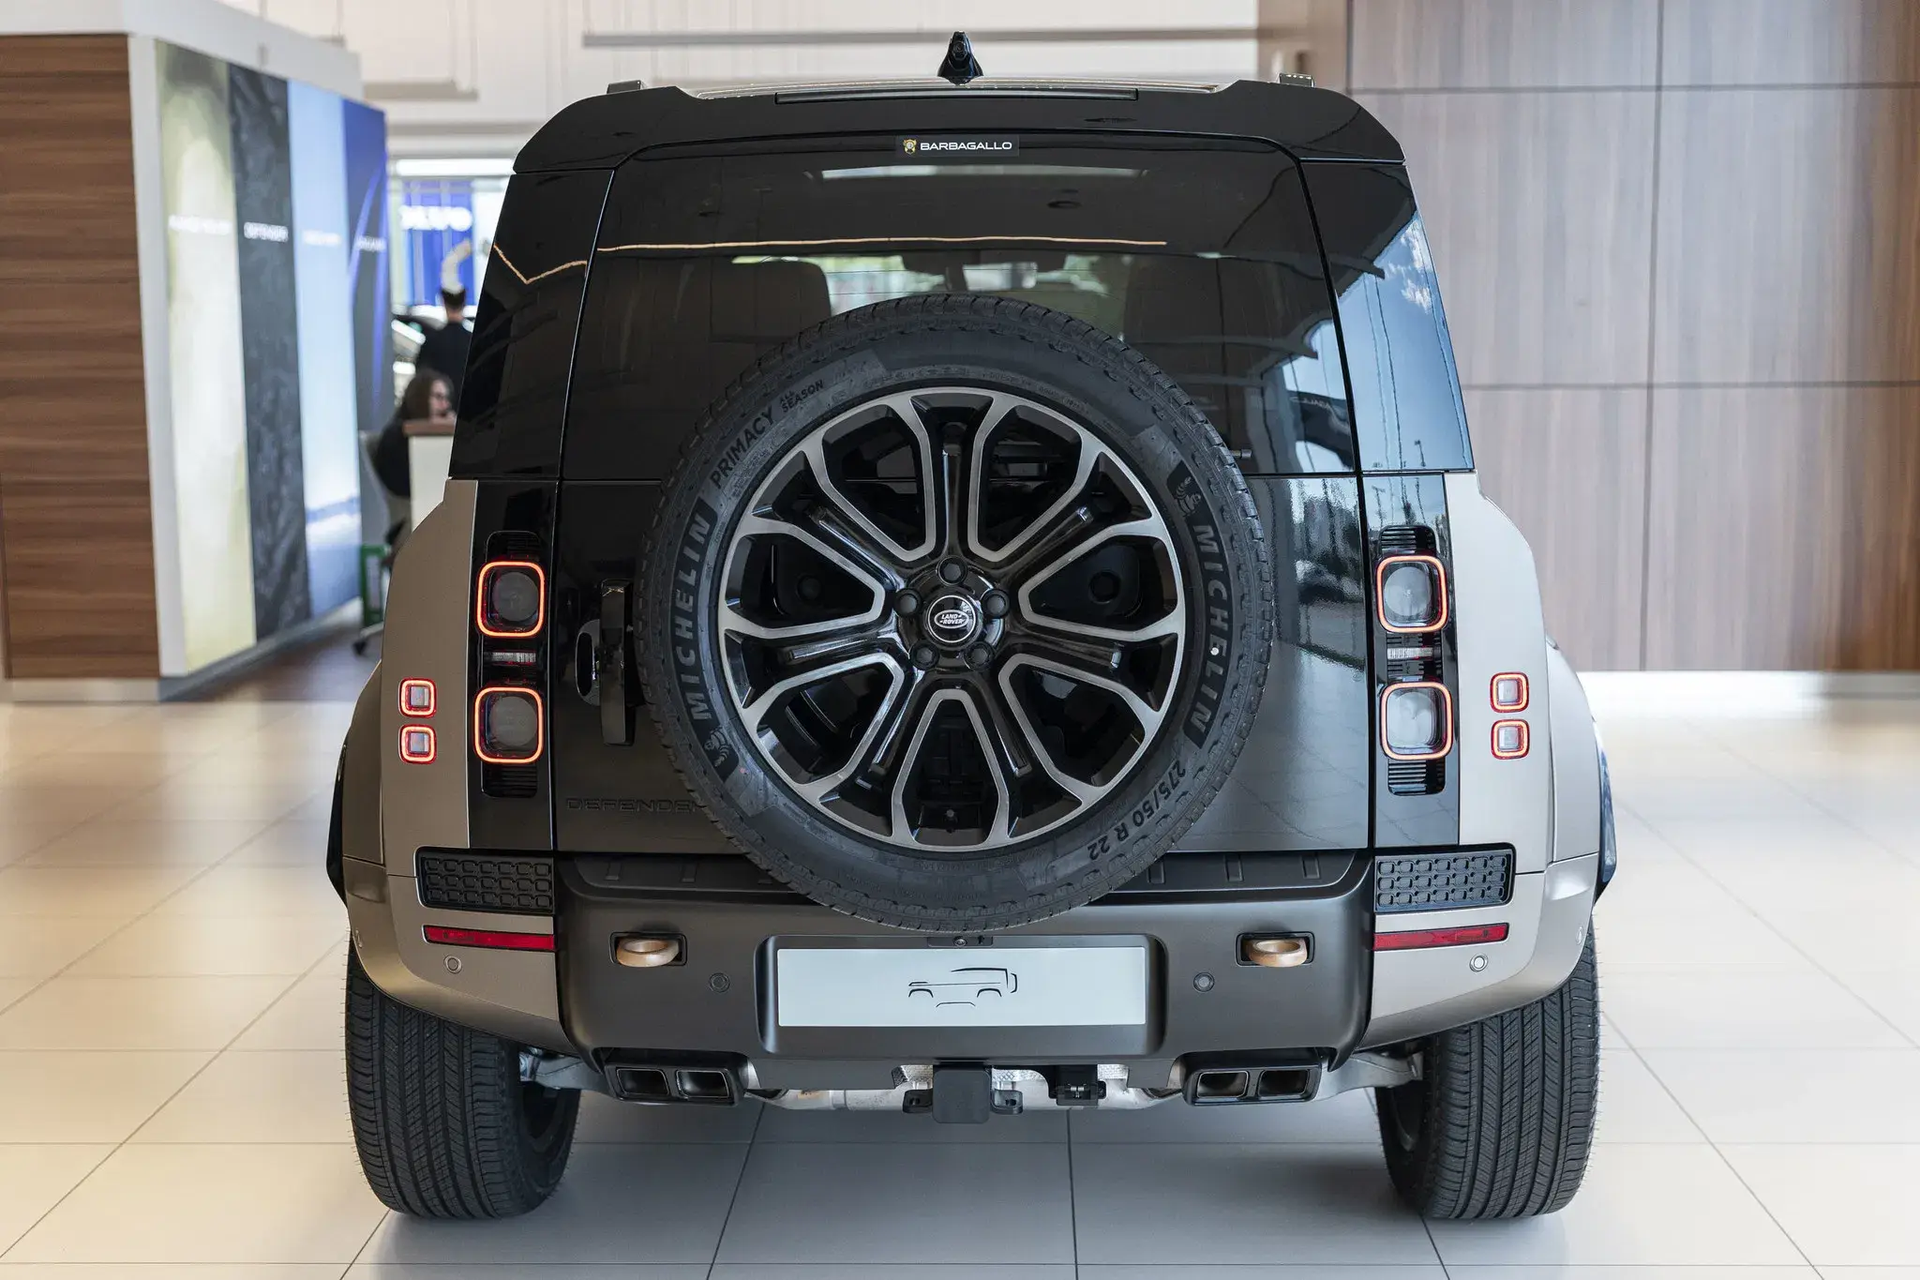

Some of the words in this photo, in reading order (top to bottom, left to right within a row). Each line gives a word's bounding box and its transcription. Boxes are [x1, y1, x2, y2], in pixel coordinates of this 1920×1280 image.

[920, 142, 1013, 151] BARBAGALLO
[779, 390, 796, 404] ALL
[781, 379, 825, 414] SEASON
[711, 407, 774, 487] PRIMACY
[676, 513, 711, 721] MICHELIN
[1194, 524, 1230, 737] MICHELIN
[1132, 761, 1187, 828] 275/50
[1087, 835, 1111, 860] 22
[1114, 821, 1130, 843] R
